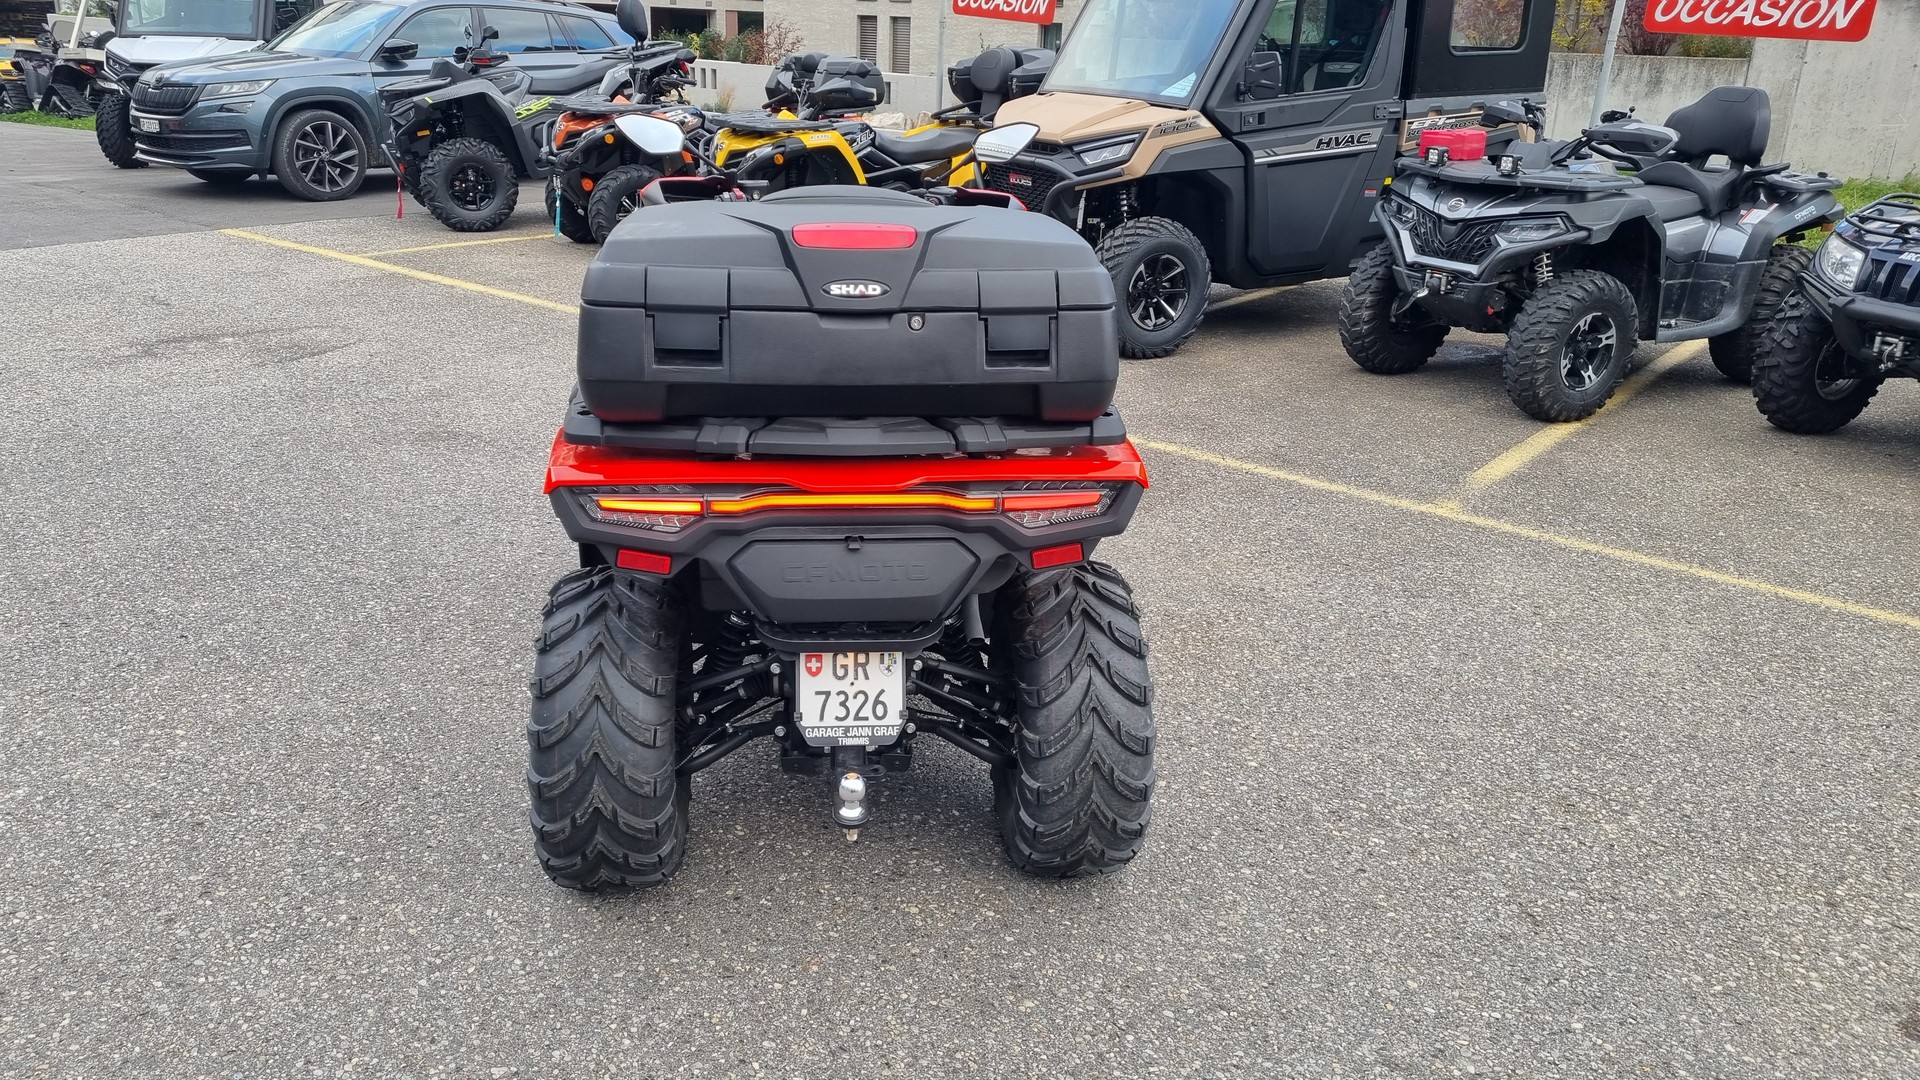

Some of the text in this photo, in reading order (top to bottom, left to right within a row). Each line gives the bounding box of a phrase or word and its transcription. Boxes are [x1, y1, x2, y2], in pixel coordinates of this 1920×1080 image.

[1654, 0, 1863, 30] OCCASION
[1314, 131, 1373, 151] HVAC
[829, 284, 882, 295] SHAD
[783, 561, 929, 583] CFMOTO
[832, 652, 870, 681] GR
[814, 688, 889, 722] 7326
[805, 726, 900, 738] GARAGE JANN GRAF
[838, 737, 870, 746] TRIMMIS
